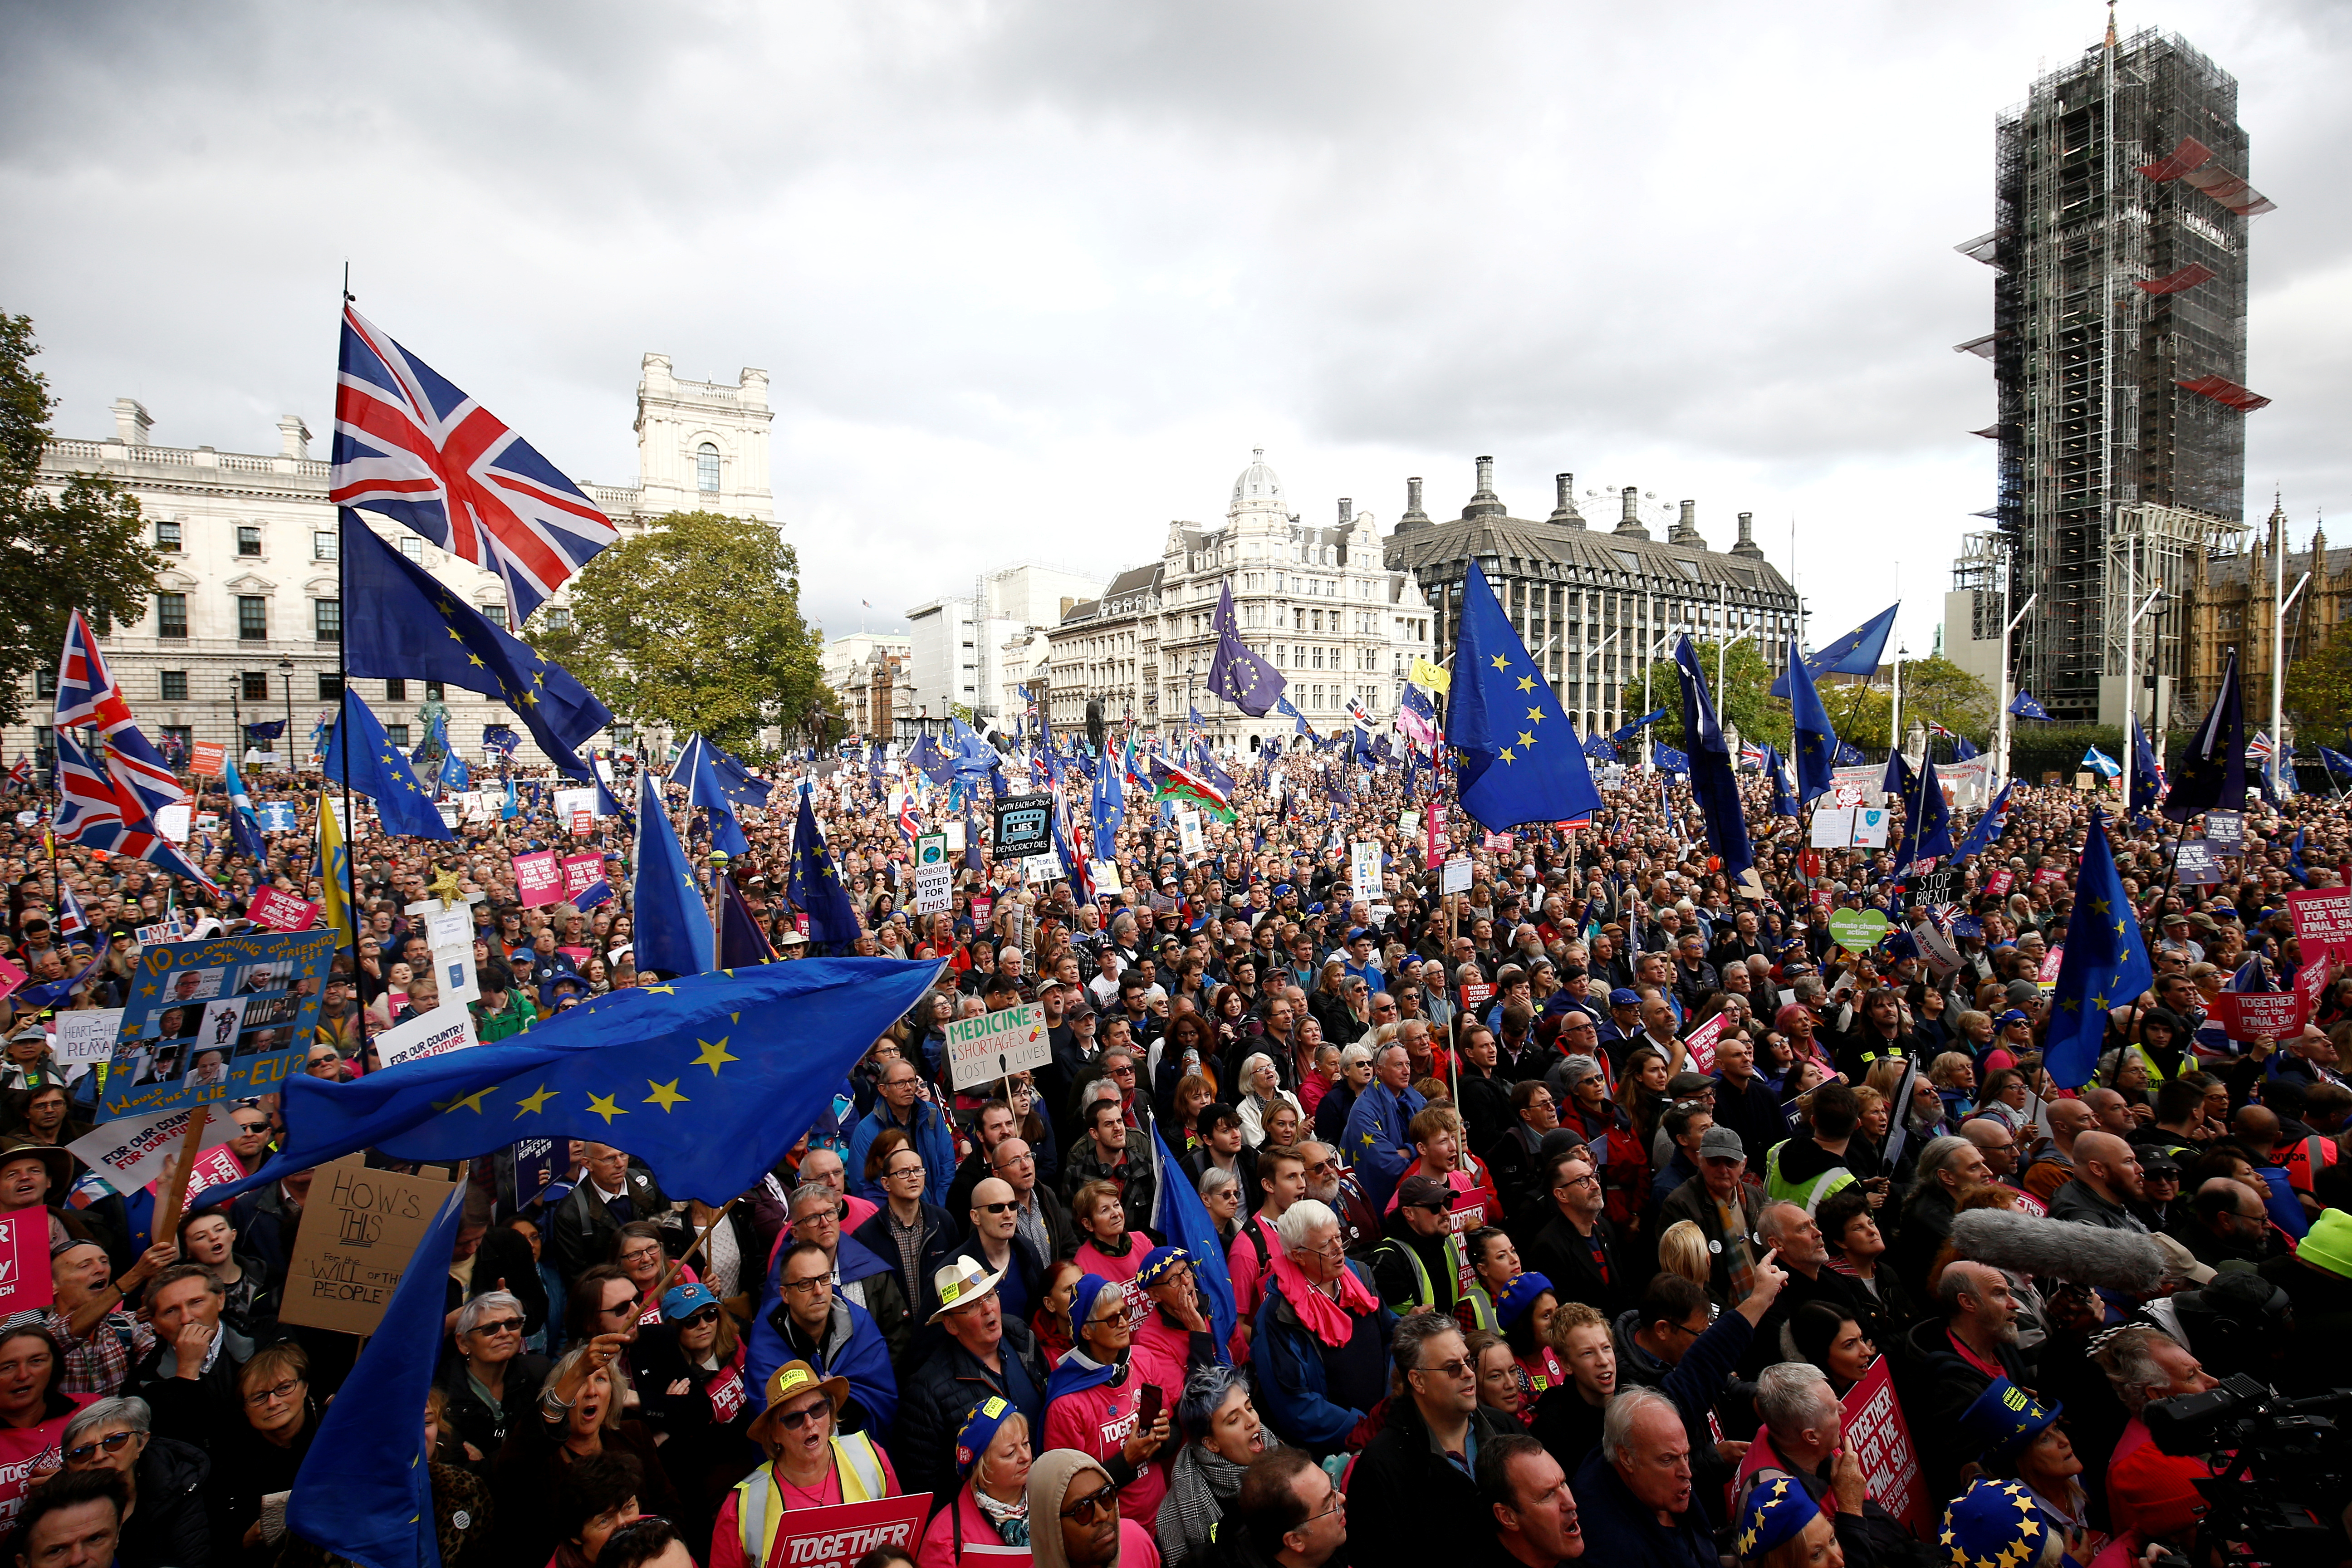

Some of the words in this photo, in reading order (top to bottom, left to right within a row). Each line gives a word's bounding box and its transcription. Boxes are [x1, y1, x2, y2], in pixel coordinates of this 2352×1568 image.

[1953, 771, 1976, 779] PARTY
[997, 803, 1014, 812] WITH
[1014, 801, 1029, 810] EACH
[1035, 798, 1051, 808] YOUR
[1012, 822, 1033, 833] LIES
[1435, 833, 1446, 845] FINAL
[996, 842, 1033, 854] DEMOCRACY
[1358, 843, 1379, 853] TIME
[1358, 852, 1373, 862] FOR
[1376, 851, 1381, 861] A
[518, 858, 552, 871] TOGETHER
[523, 867, 537, 877] FOR
[538, 864, 551, 875] THE
[567, 860, 600, 872] TOGETHER
[916, 865, 949, 876] NOBODY
[1359, 862, 1376, 878] EU
[522, 874, 541, 886] FINAL
[542, 871, 555, 881] SAY
[572, 869, 585, 879] FOR
[586, 866, 599, 876] THE
[570, 877, 588, 887] FINAL
[589, 874, 602, 883] SAY
[917, 877, 948, 888] VOTED
[1919, 872, 1951, 891] STOP
[925, 888, 943, 898] FOR
[1360, 883, 1381, 895] TURN
[269, 891, 306, 913] TOGETHER
[1916, 887, 1951, 906] BREXIT
[284, 906, 295, 914] the
[920, 897, 950, 911] THIS!
[263, 904, 285, 918] FINAL
[284, 912, 300, 925] SAY
[2303, 910, 2328, 921] FOR
[2329, 909, 2352, 919] THE
[149, 924, 172, 940] MY
[1859, 923, 1885, 932] change
[2302, 921, 2336, 932] FINAL
[277, 933, 336, 961] FRIENDS
[1924, 940, 1933, 949] OUR
[1933, 949, 1954, 967] COUNTRY
[144, 947, 173, 976] 10
[180, 938, 262, 965] CLOWNING
[268, 936, 291, 954] and
[1921, 944, 1930, 955] OUR
[1928, 953, 1949, 969] FUTURE
[2042, 954, 2058, 978] TOGETHER
[2303, 956, 2326, 981] TOGETHER
[2238, 996, 2295, 1007] TOGETHER
[2254, 1008, 2269, 1016] for
[2270, 1007, 2285, 1015] the
[949, 1007, 1032, 1044] MEDICINE
[2242, 1016, 2275, 1026] FINAL
[2278, 1014, 2295, 1025] SAY
[64, 1025, 93, 1039] HEART
[1691, 1024, 1720, 1049] TOGETHER
[390, 1050, 409, 1066] FOR
[408, 1041, 426, 1056] OUR
[426, 1022, 464, 1048] COUNTRY
[432, 1034, 466, 1055] FUTURE
[958, 1029, 1024, 1061] SHORTAGES
[1702, 1042, 1710, 1051] for
[1709, 1037, 1718, 1045] the
[956, 1060, 987, 1082] COST
[1015, 1045, 1046, 1064] LIVES
[107, 1088, 163, 1115] WOULD
[151, 1088, 190, 1107] THEY
[196, 1085, 227, 1102] LIE
[231, 1070, 247, 1083] TO
[101, 1146, 132, 1165] FOR
[130, 1127, 158, 1148] OUR
[156, 1109, 192, 1131] COUNT
[115, 1151, 145, 1170] FOR
[142, 1132, 171, 1152] OUR
[518, 1140, 540, 1161] PEOPLE'S
[535, 1140, 552, 1158] 19.10.19
[331, 1169, 420, 1218] HOW'S
[338, 1208, 383, 1243] THIS
[1450, 1206, 1483, 1231] TOGETHER
[323, 1252, 340, 1262] For
[344, 1255, 361, 1265] the
[368, 1272, 379, 1280] OF
[1127, 1296, 1139, 1307] for
[782, 1370, 803, 1380] BOLLOCKS
[729, 1400, 739, 1413] for
[984, 1398, 996, 1412] BOLLOCKS
[991, 1399, 1000, 1410] BREXIT
[1848, 1386, 1894, 1450] TOGETHER
[1861, 1436, 1883, 1475] FOR
[1878, 1413, 1899, 1450] THE
[1866, 1459, 1895, 1499] FINAL
[1891, 1435, 1908, 1472] SAY
[1893, 1477, 1905, 1496] VOTE
[1902, 1460, 1917, 1485] MARCH
[1892, 1491, 1910, 1519] 19.10.19
[789, 1523, 910, 1564] TOGETHER
